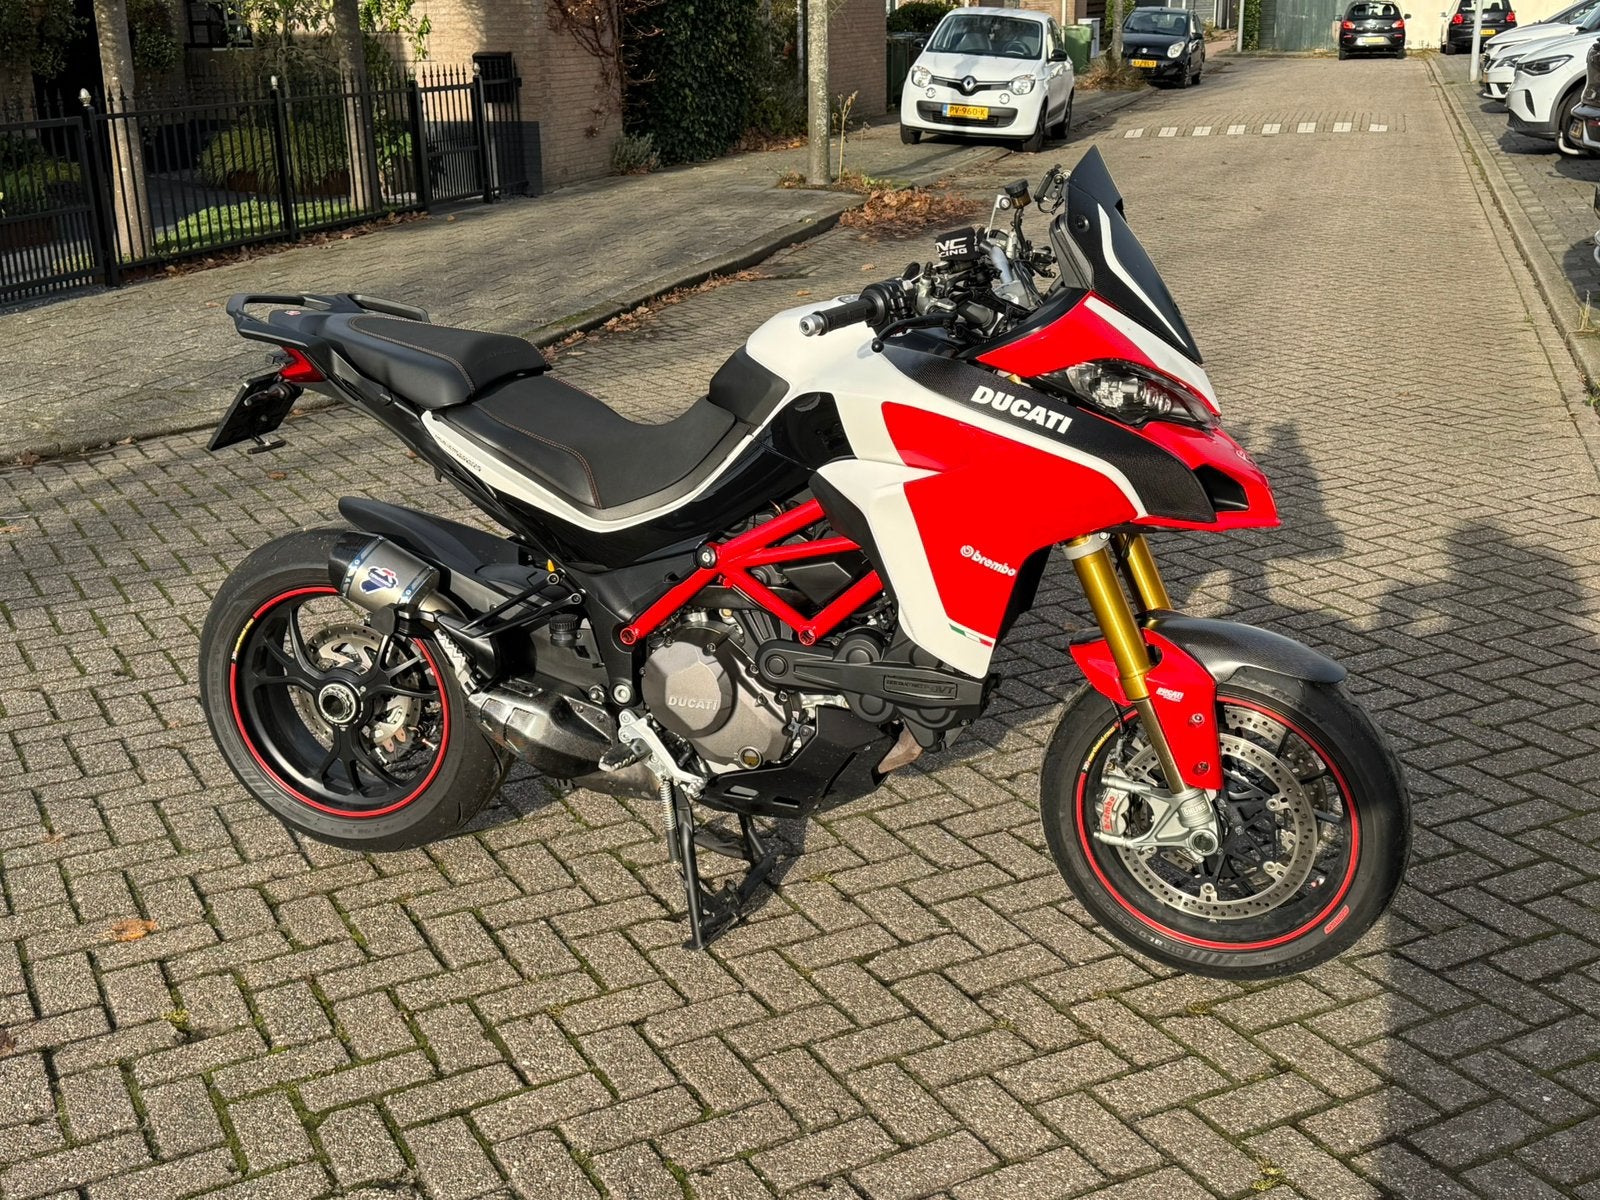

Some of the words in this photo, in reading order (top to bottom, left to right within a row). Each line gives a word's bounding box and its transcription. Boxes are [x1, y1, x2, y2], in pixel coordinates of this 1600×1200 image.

[970, 385, 1073, 435] DUCATI
[971, 549, 1017, 577] brembo
[668, 695, 719, 711] DUCATI
